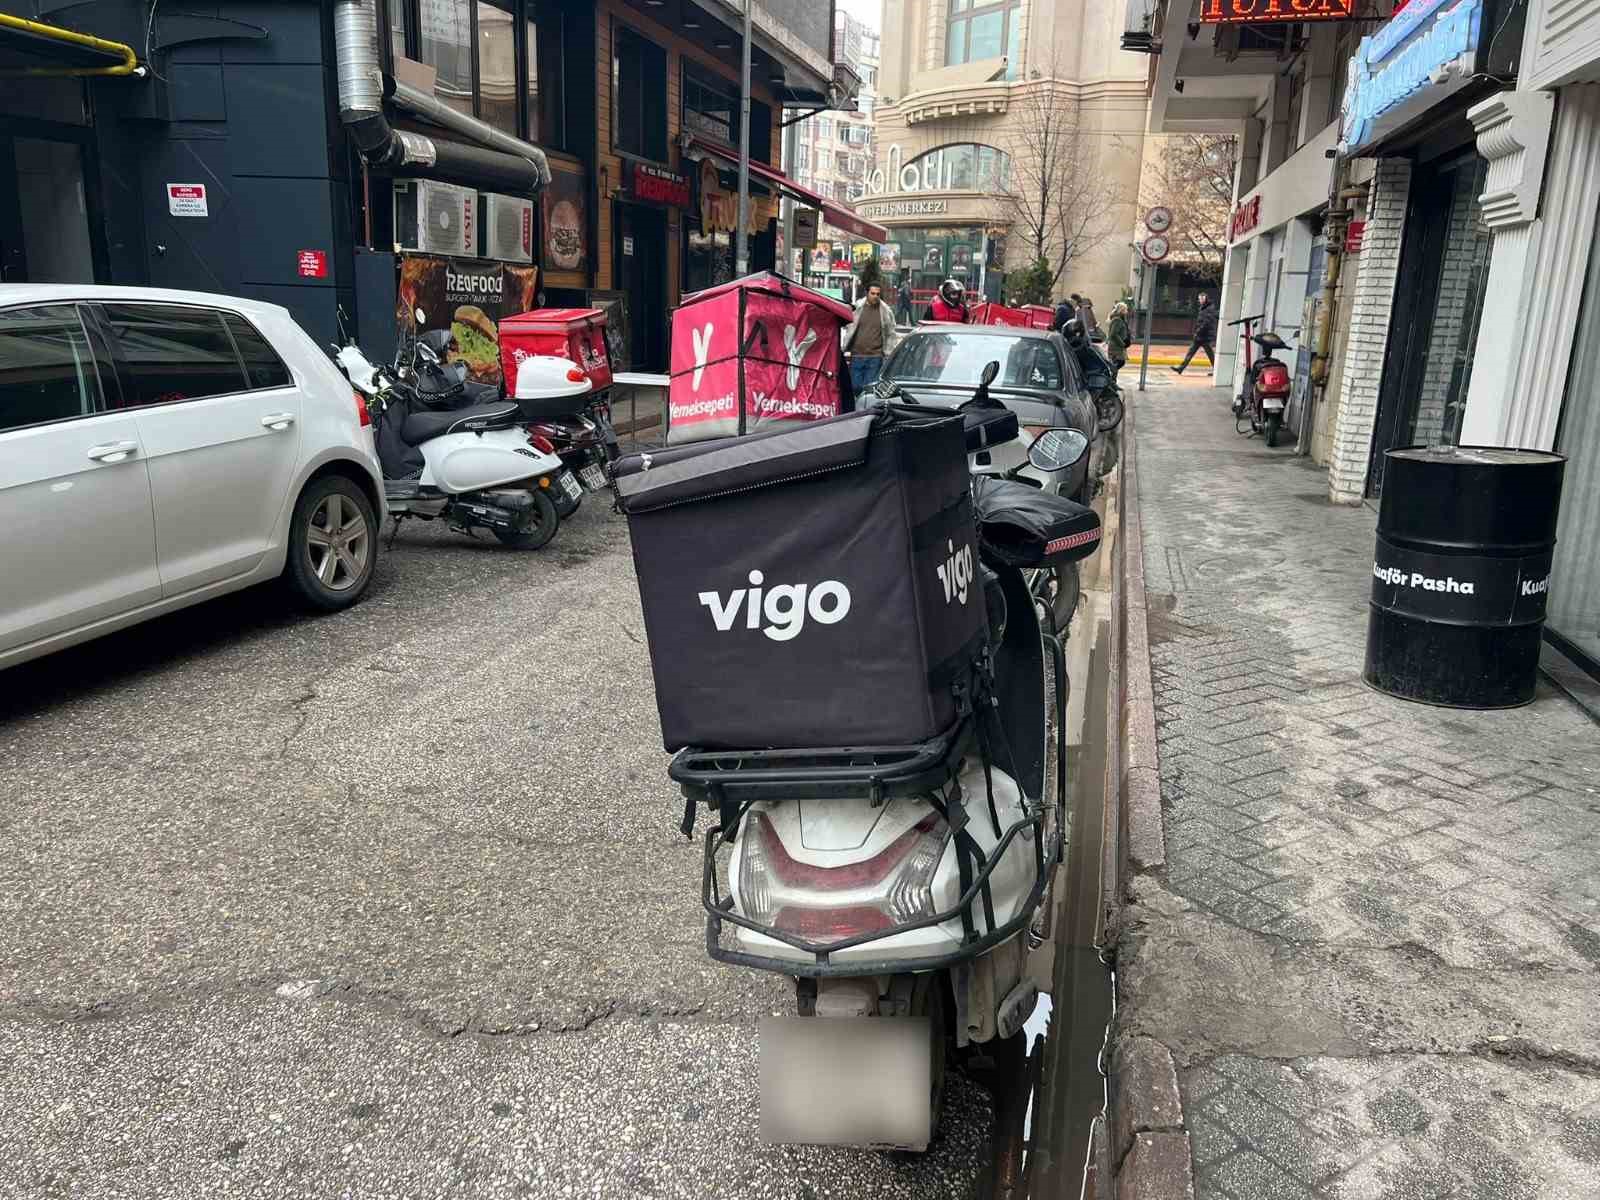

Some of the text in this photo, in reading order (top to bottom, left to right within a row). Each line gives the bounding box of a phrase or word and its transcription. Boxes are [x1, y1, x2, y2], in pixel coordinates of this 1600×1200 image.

[669, 392, 734, 419] Yemeksepeti
[752, 391, 837, 418] Yemeksepeti
[937, 539, 973, 605] vigo
[1410, 572, 1475, 595] Pasha
[698, 569, 851, 641] vigo
